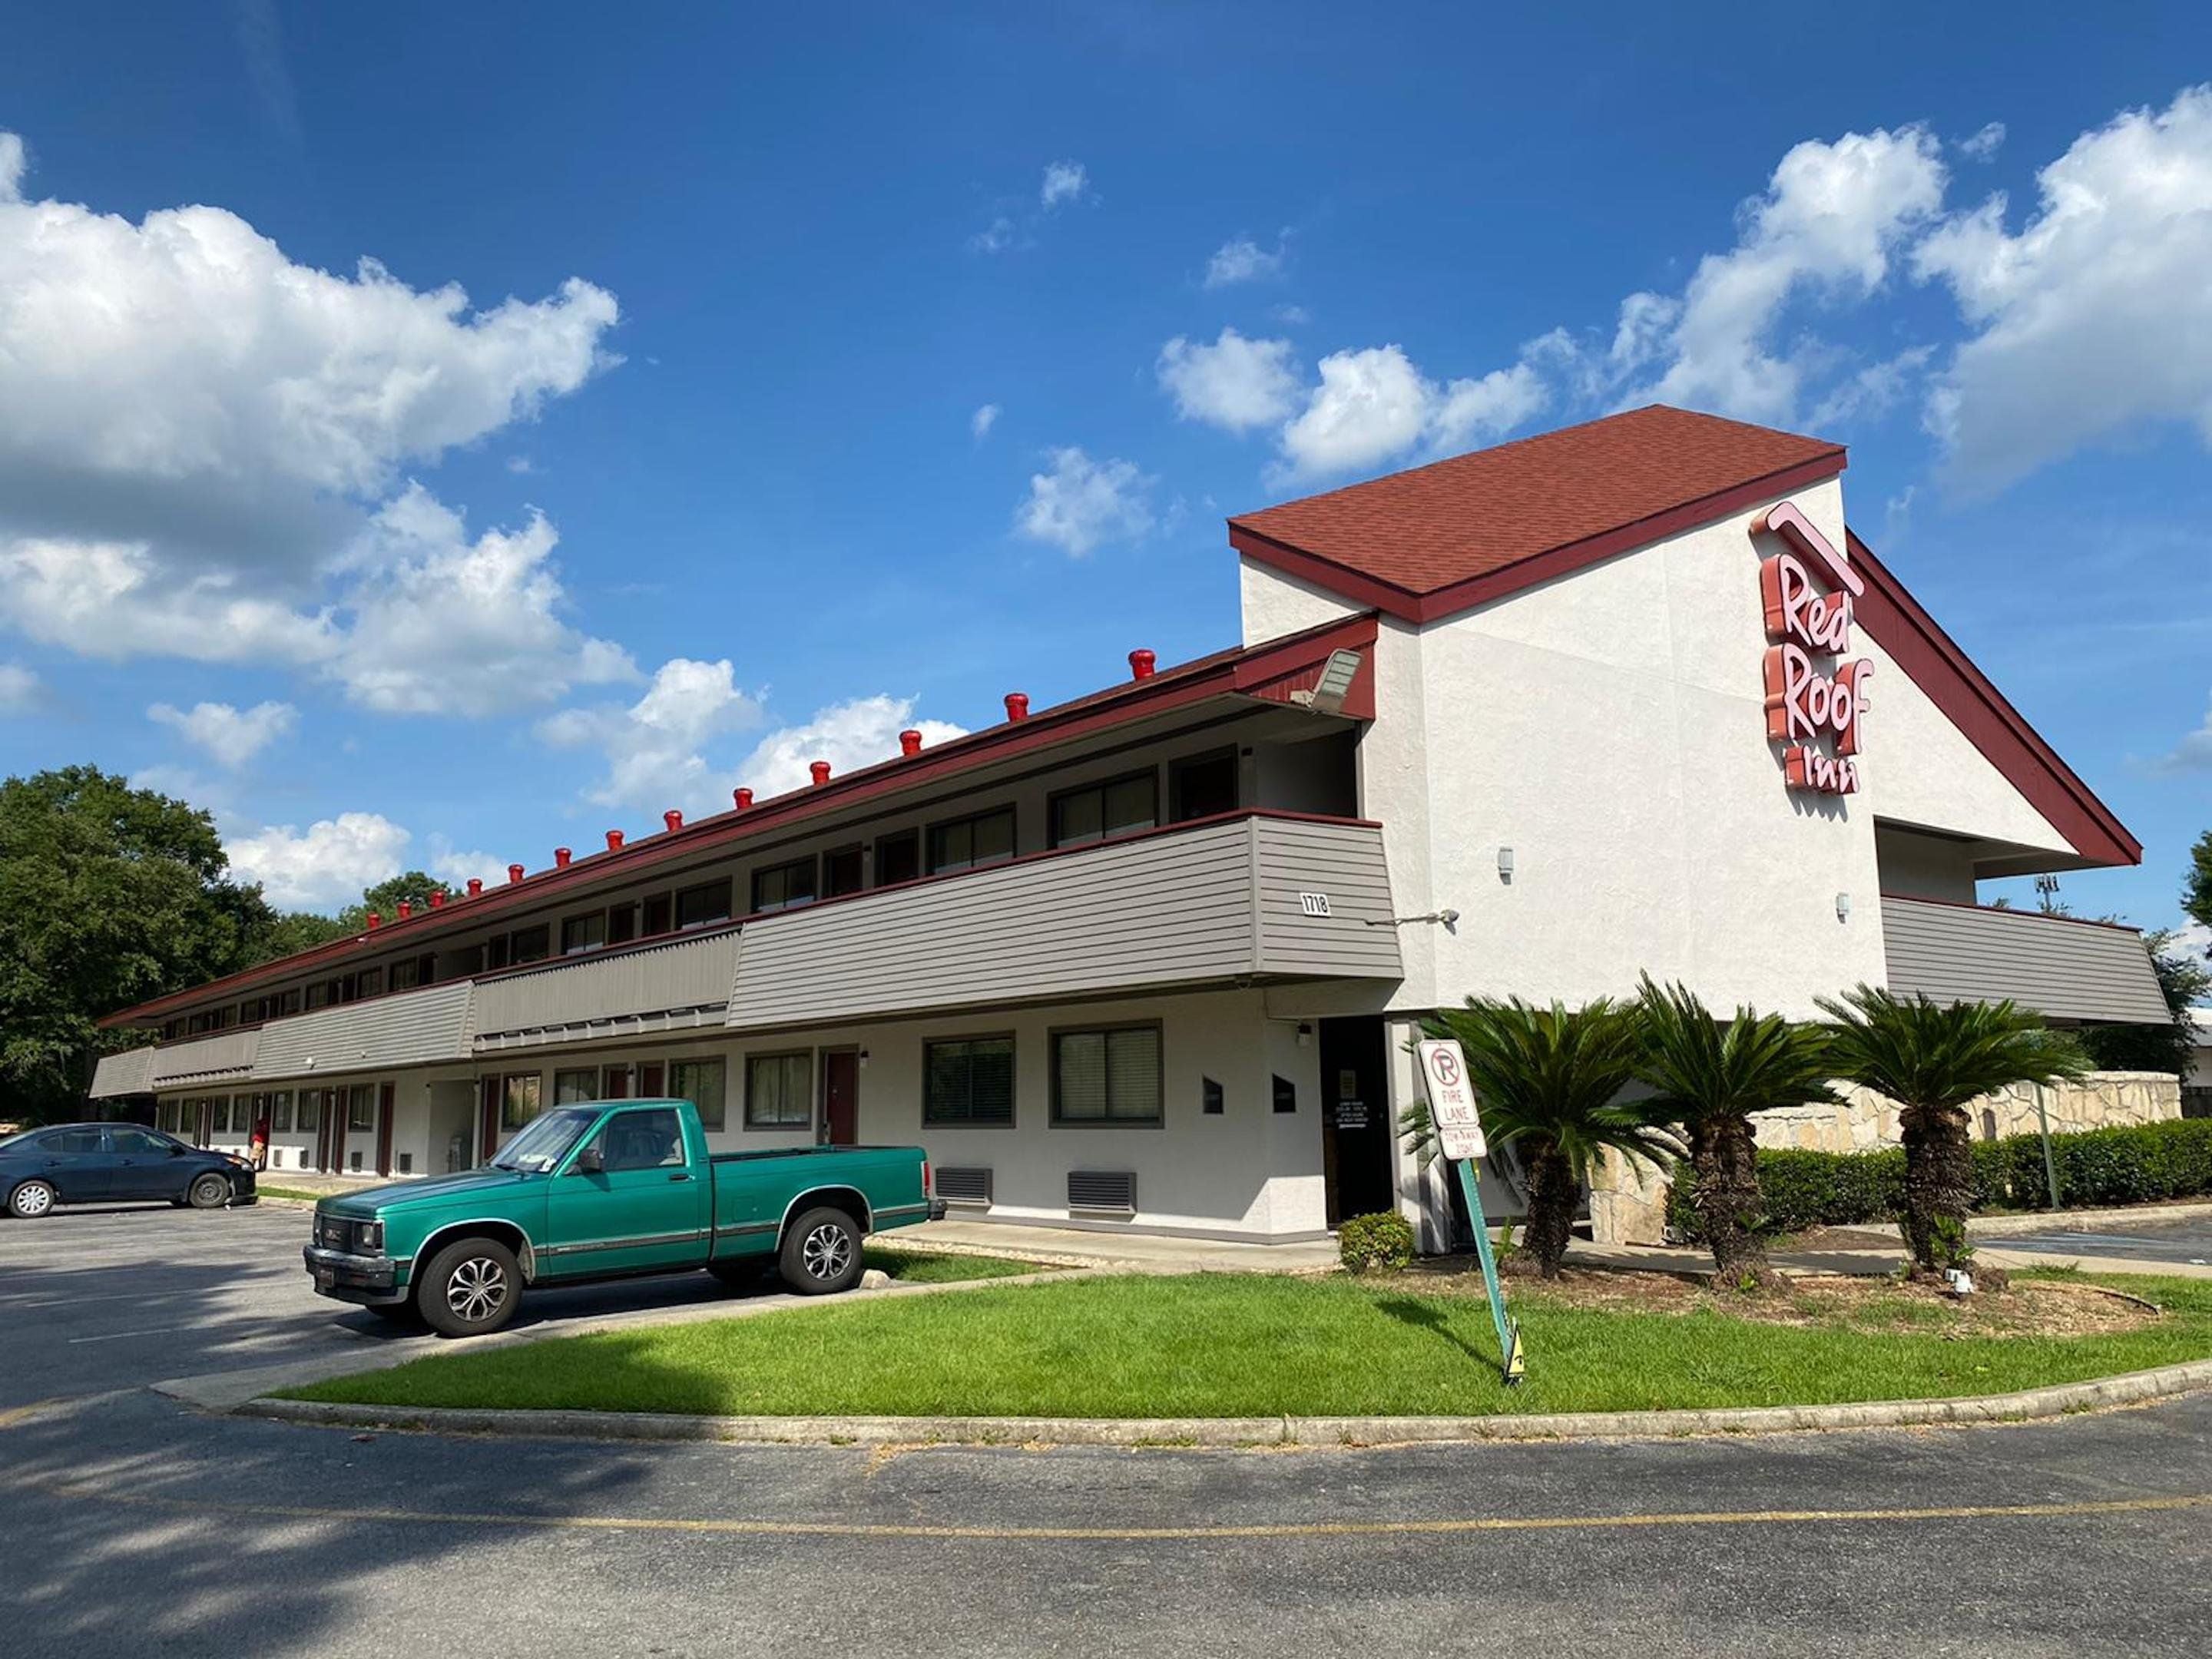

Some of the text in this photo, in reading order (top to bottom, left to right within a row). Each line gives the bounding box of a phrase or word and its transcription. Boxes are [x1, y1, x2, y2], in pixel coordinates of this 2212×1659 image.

[1774, 553, 1850, 654] Red
[1780, 642, 1875, 755] Roof
[1303, 895, 1327, 913] 1718
[1442, 1089, 1464, 1104] FIRE
[1444, 1106, 1470, 1121] LANE
